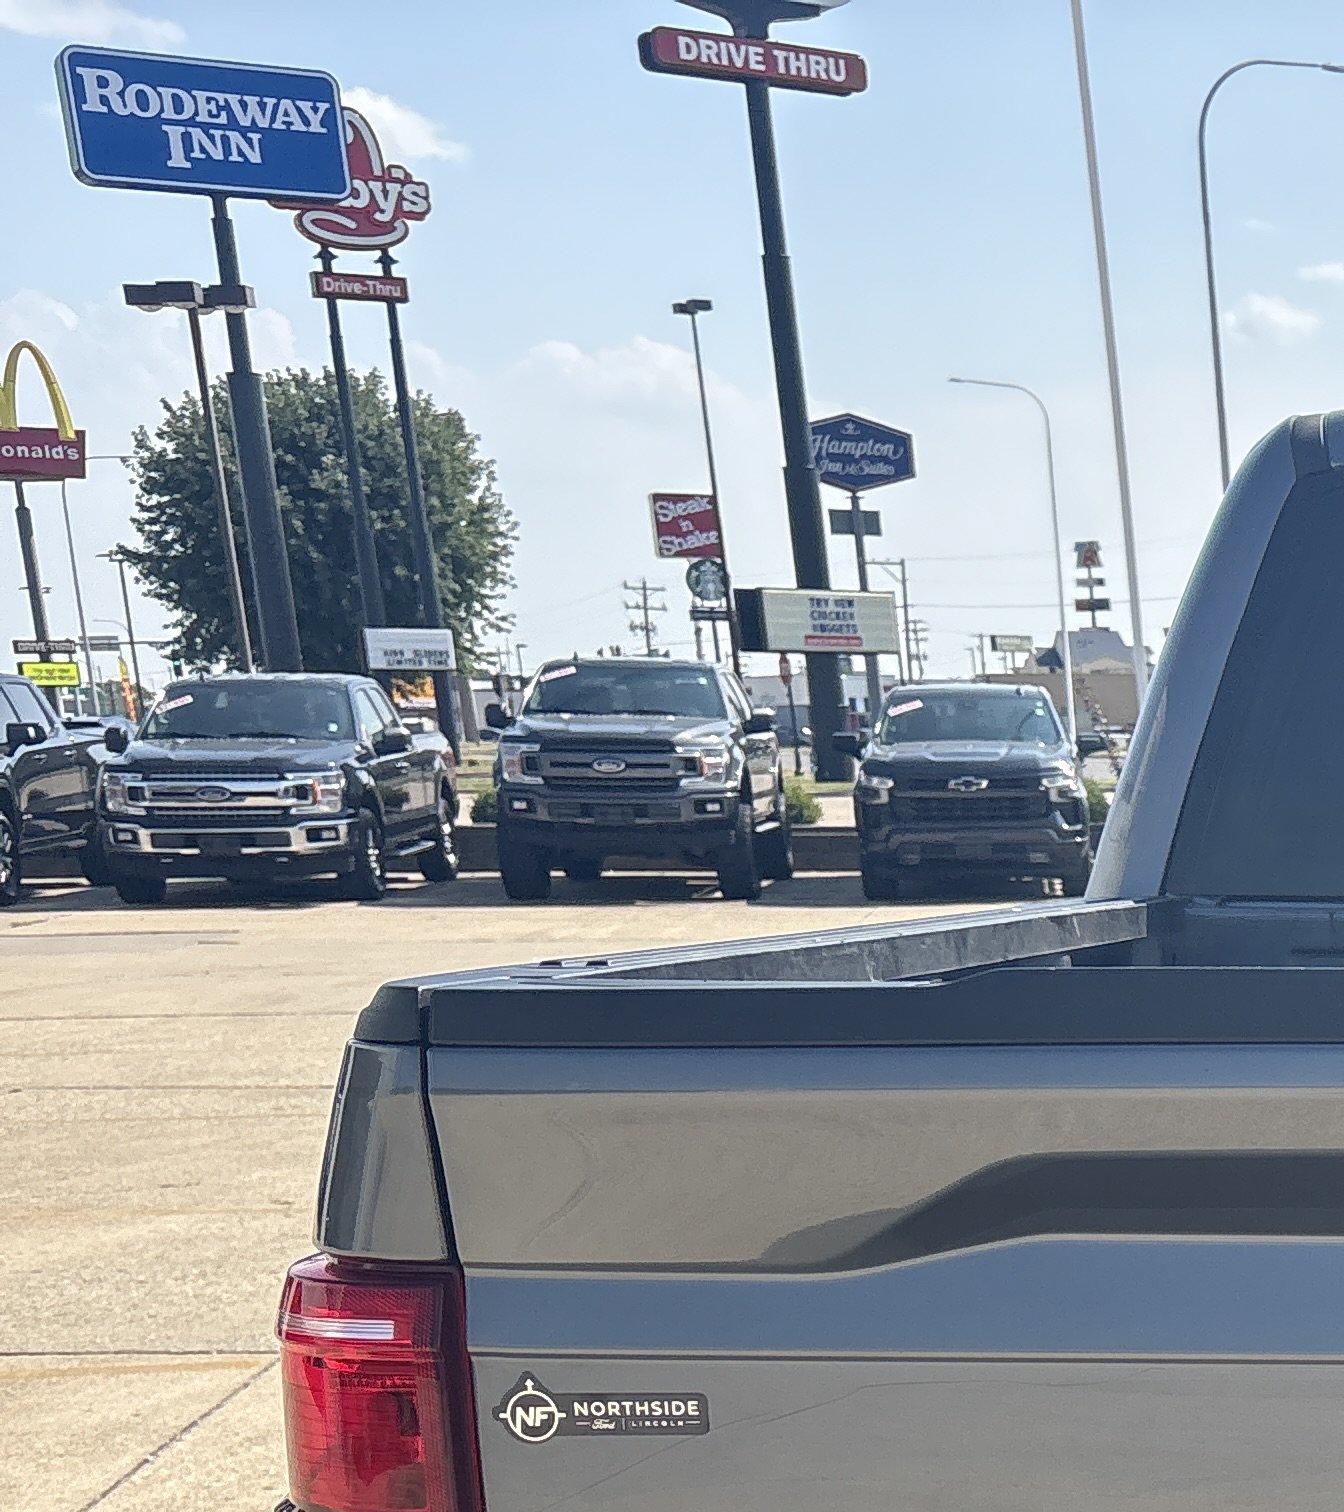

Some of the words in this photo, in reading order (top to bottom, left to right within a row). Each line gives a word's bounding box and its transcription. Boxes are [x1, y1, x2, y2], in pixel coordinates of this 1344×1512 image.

[677, 36, 766, 72] DRIVE
[772, 50, 848, 82] THRU
[76, 66, 330, 134] RODEWAY
[162, 124, 262, 169] INN
[337, 168, 430, 222] by's
[322, 277, 401, 297] Drive-Thru
[1, 444, 80, 460] onald's
[811, 434, 904, 460] Hampton
[820, 460, 847, 476] Inn
[858, 460, 896, 476] Suites
[655, 497, 714, 523] Steak
[659, 530, 720, 556] Shake
[808, 597, 829, 609] TRY
[515, 1406, 556, 1434] NF
[573, 1400, 700, 1417] NORTHSIDE
[591, 1418, 616, 1430] Ford
[631, 1420, 685, 1428] LINCOLN
